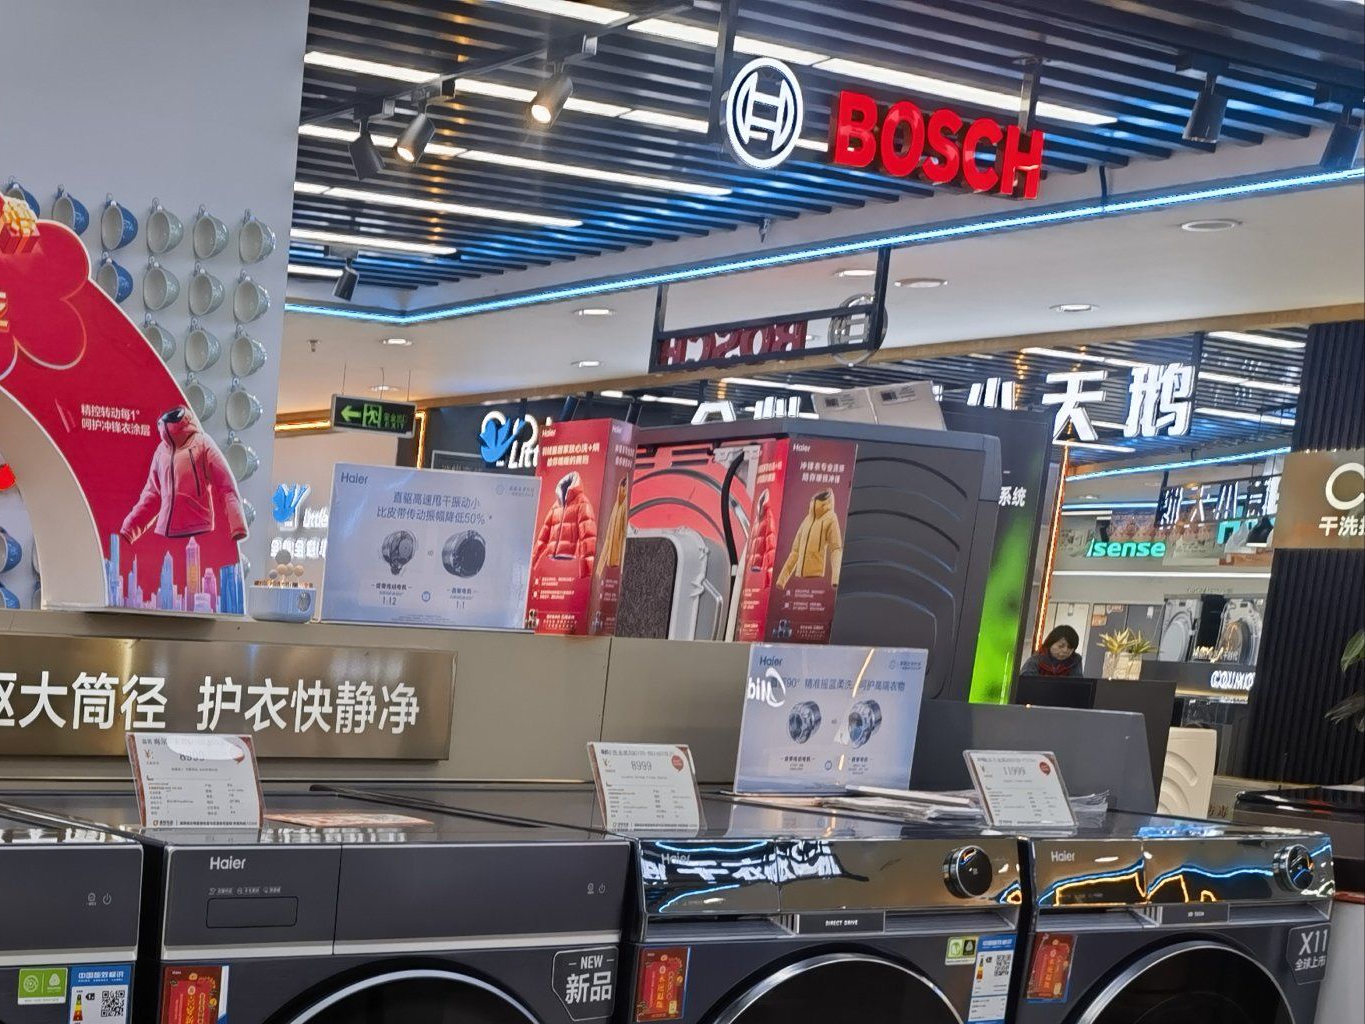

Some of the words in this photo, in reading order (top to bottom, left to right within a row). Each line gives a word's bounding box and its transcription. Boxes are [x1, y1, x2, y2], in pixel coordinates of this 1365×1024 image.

[834, 90, 1045, 200] BOSCH
[340, 471, 369, 485] Haier
[392, 490, 481, 509] 直驱高速甩干振动小
[998, 485, 1027, 507] 系统
[759, 655, 784, 667] Haier
[196, 676, 421, 736] 护衣快静净
[209, 855, 247, 871] Haier
[1051, 850, 1075, 863] Haier
[1298, 928, 1328, 956] X11
[580, 954, 604, 970] NEW
[1294, 955, 1327, 972] 全球上市
[78, 970, 125, 980] 中国能效标识
[565, 970, 613, 1005] 新品
